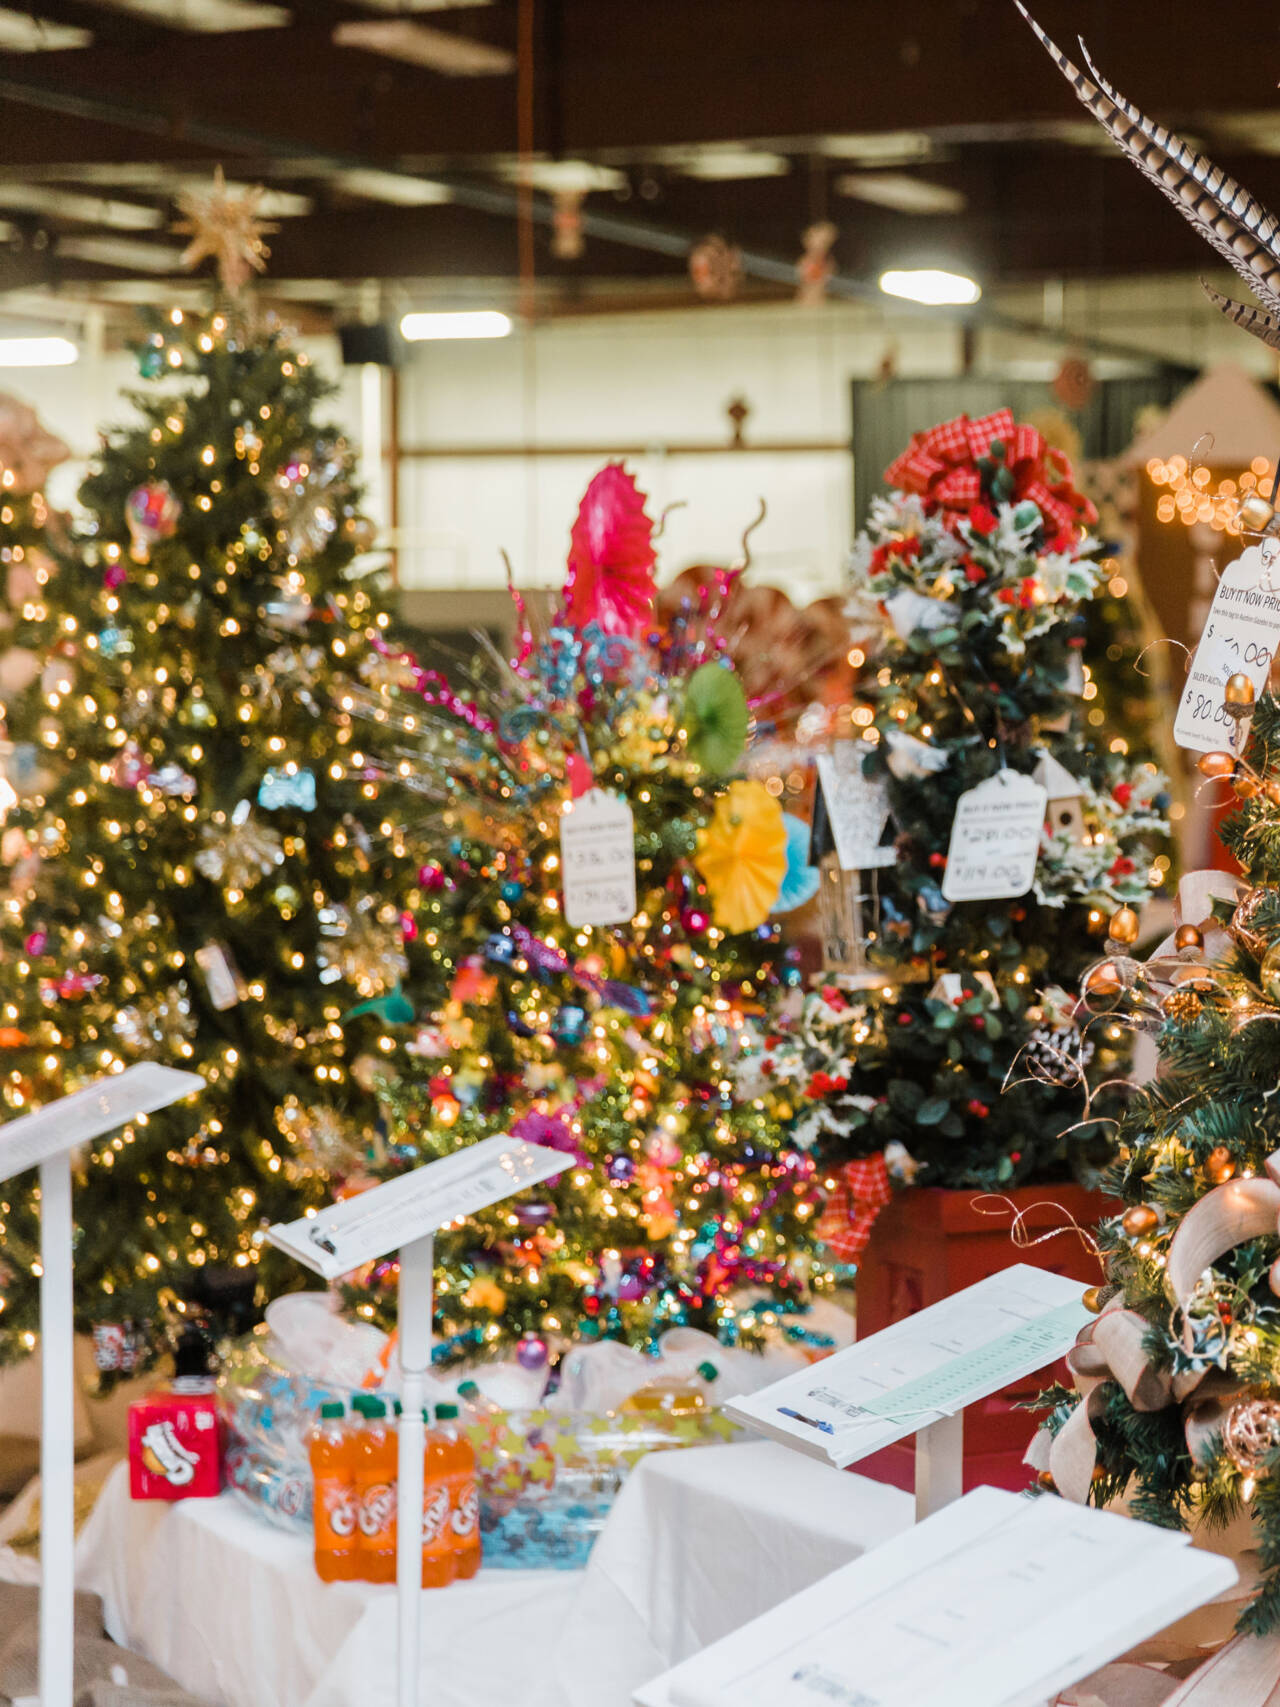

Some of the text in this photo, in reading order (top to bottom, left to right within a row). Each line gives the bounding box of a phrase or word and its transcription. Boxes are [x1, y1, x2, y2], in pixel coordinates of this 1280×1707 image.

[1219, 585, 1236, 600] BUY
[1235, 590, 1244, 603] IT
[1243, 591, 1264, 607] NOW
